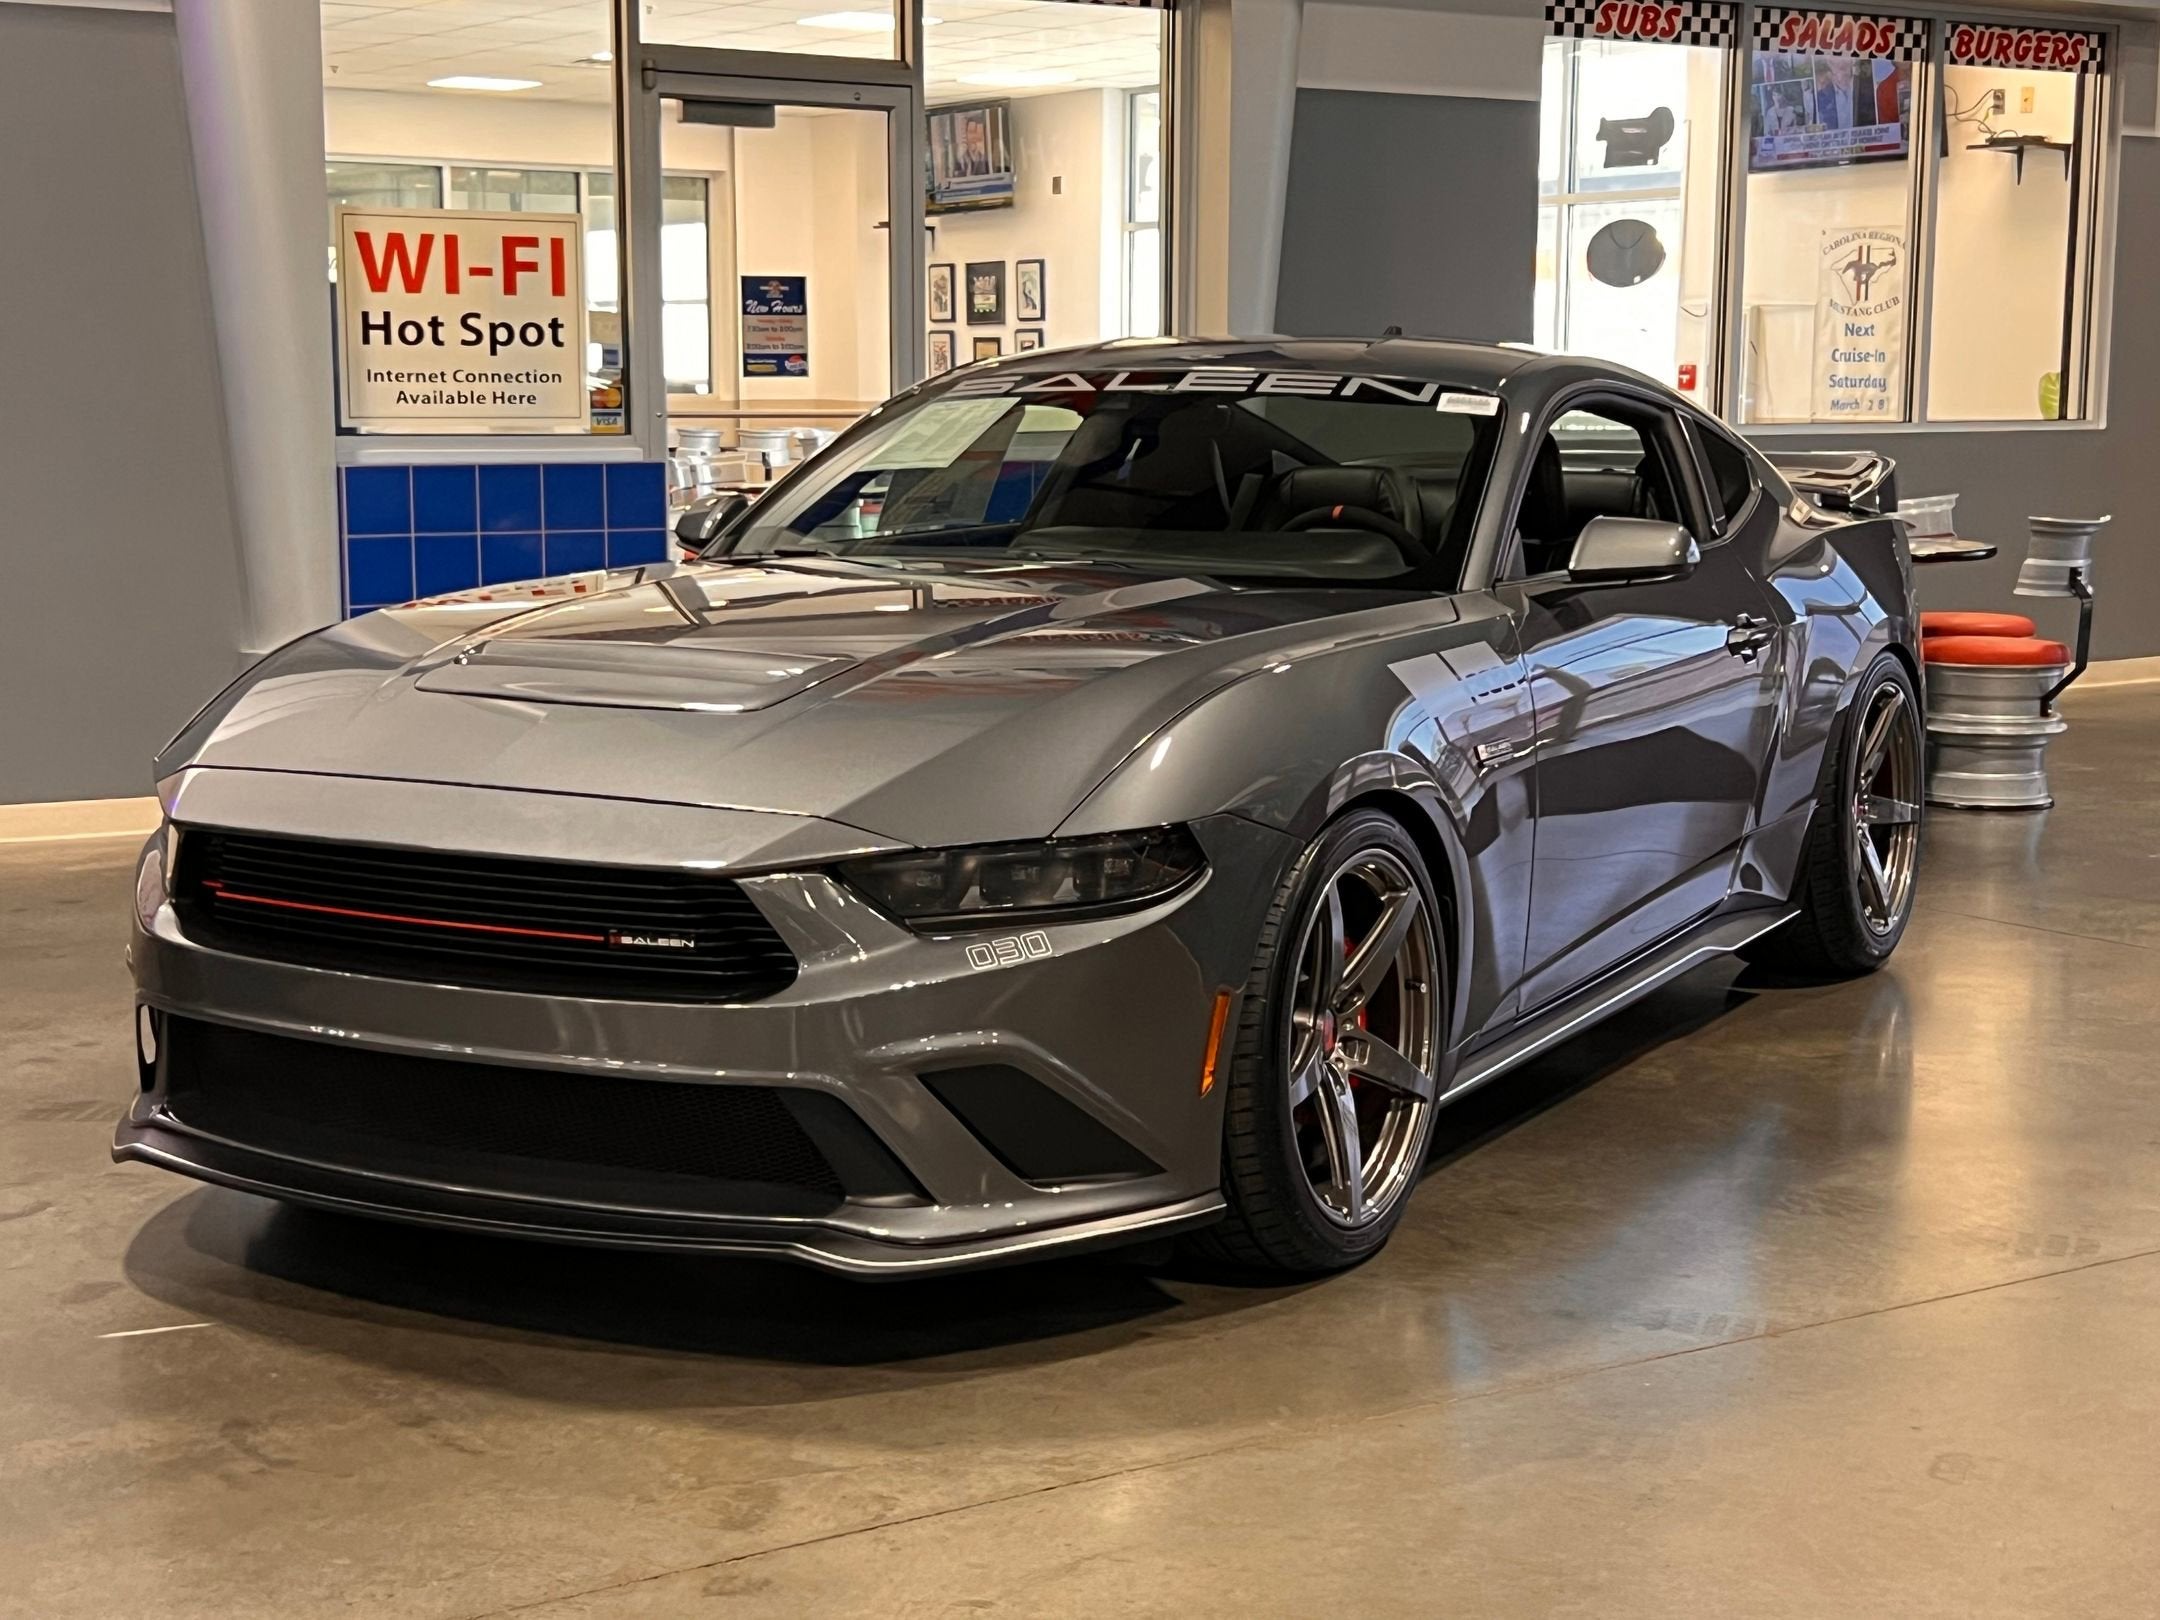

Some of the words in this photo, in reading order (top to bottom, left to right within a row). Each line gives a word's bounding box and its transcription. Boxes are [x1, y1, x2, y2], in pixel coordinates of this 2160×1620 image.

[1595, 3, 1681, 38] SUBS
[1779, 16, 1896, 54] SALADS
[1955, 29, 2085, 68] BURGERS
[1822, 230, 1867, 255] CAROLINA
[354, 231, 566, 297] WI-FI
[1873, 296, 1900, 314] CLUB
[361, 310, 445, 346] Hot
[460, 311, 565, 356] Spot
[1844, 322, 1875, 337] Next
[1831, 347, 1886, 362] Cruise-In
[367, 368, 447, 383] Internet
[452, 369, 562, 384] Connection
[1828, 374, 1887, 393] Saturday
[396, 390, 487, 405] Available
[492, 391, 537, 405] Here
[942, 372, 1440, 403] SALEEN
[1830, 399, 1860, 411] March
[621, 936, 695, 948] SALEEN
[965, 930, 1053, 970] 030
